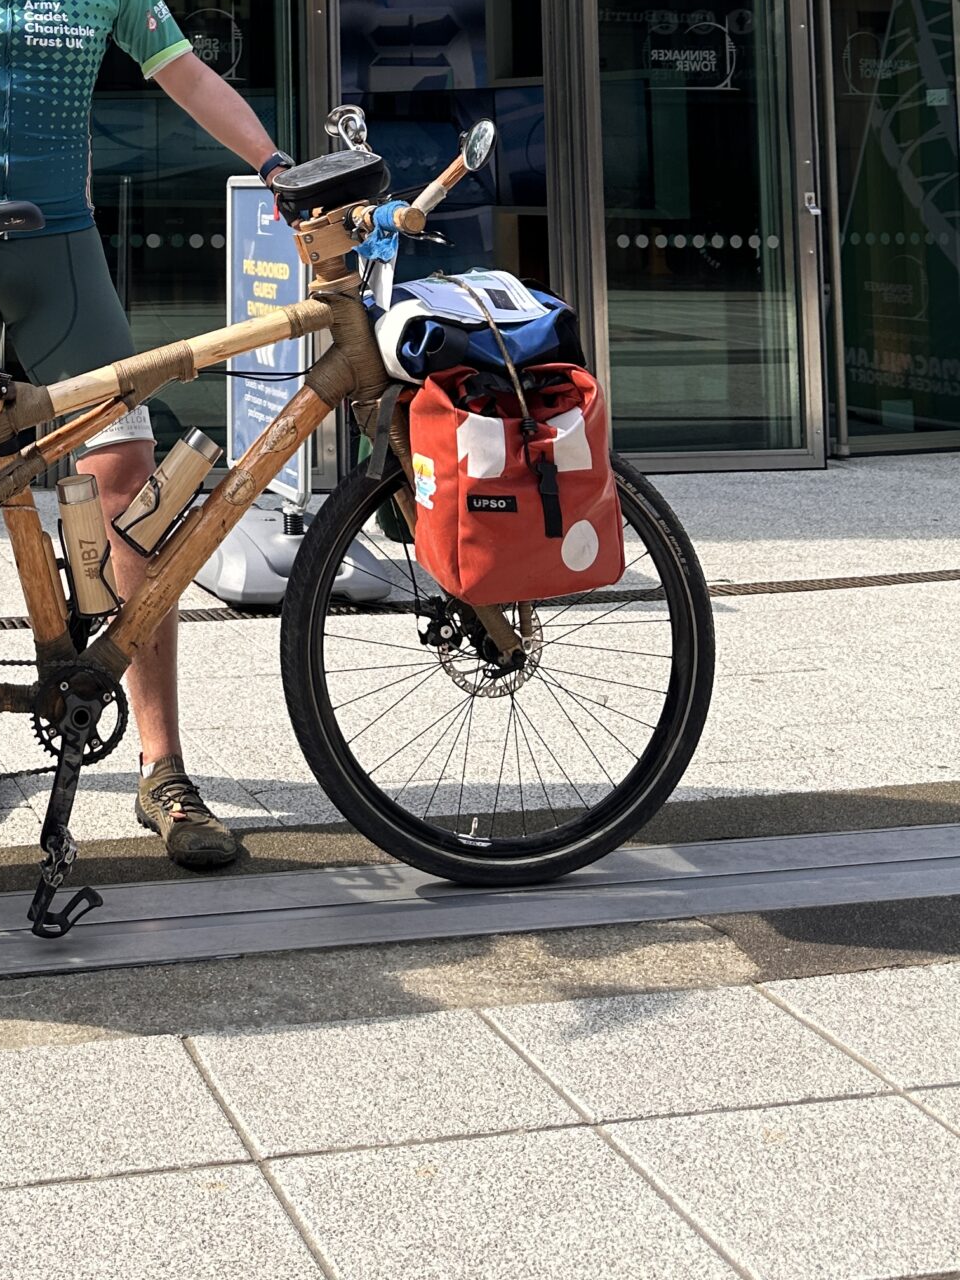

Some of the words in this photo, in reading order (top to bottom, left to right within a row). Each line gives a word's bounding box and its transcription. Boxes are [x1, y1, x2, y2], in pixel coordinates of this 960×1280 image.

[24, 0, 61, 12] Army
[24, 11, 69, 23] Cadet
[24, 23, 95, 37] Charitable
[24, 35, 64, 48] Trust
[65, 37, 84, 49] UK
[243, 259, 290, 280] PRE-BOOKED
[253, 281, 278, 300] GUEST
[472, 498, 507, 509] UPSO
